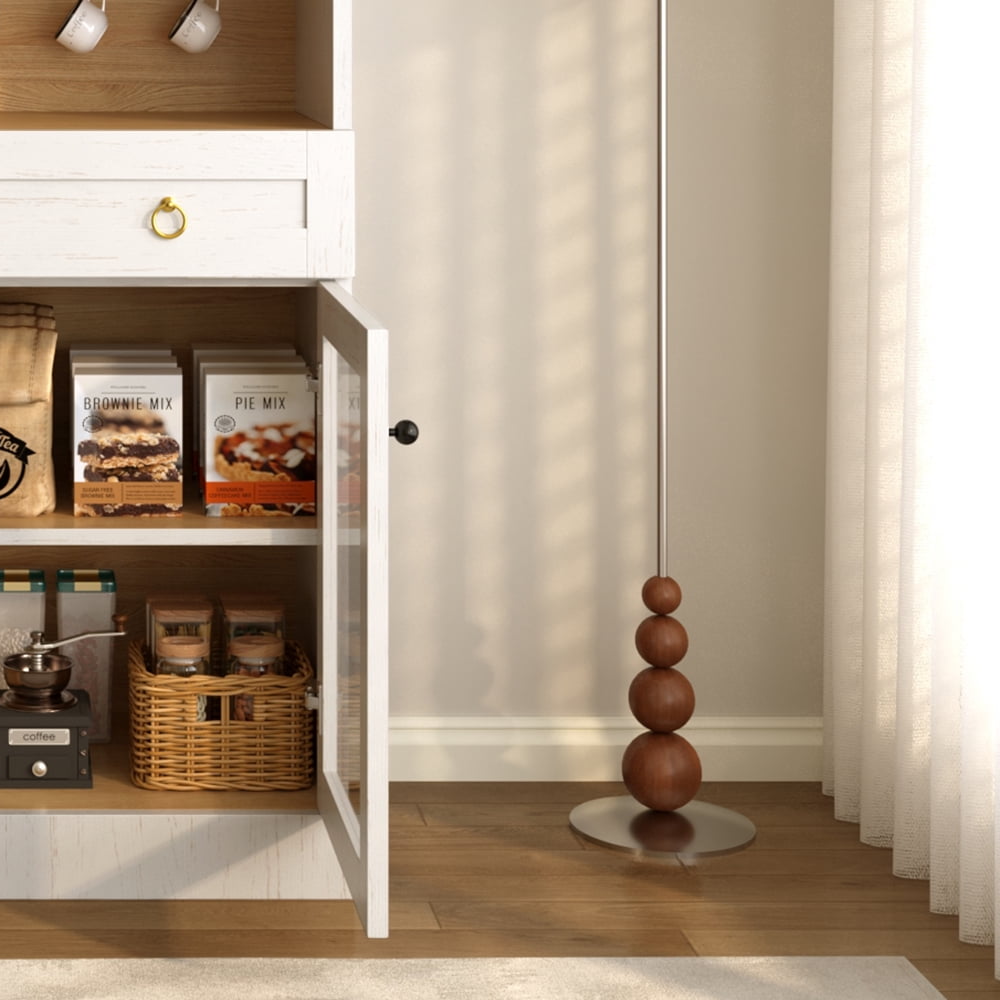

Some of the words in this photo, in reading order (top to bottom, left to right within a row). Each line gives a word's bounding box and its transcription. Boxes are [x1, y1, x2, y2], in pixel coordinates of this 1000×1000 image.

[83, 396, 143, 410] BROWNIE
[149, 397, 173, 410] MIX
[235, 396, 256, 410] PIE
[263, 396, 286, 410] MIX
[23, 731, 56, 741] coffee
